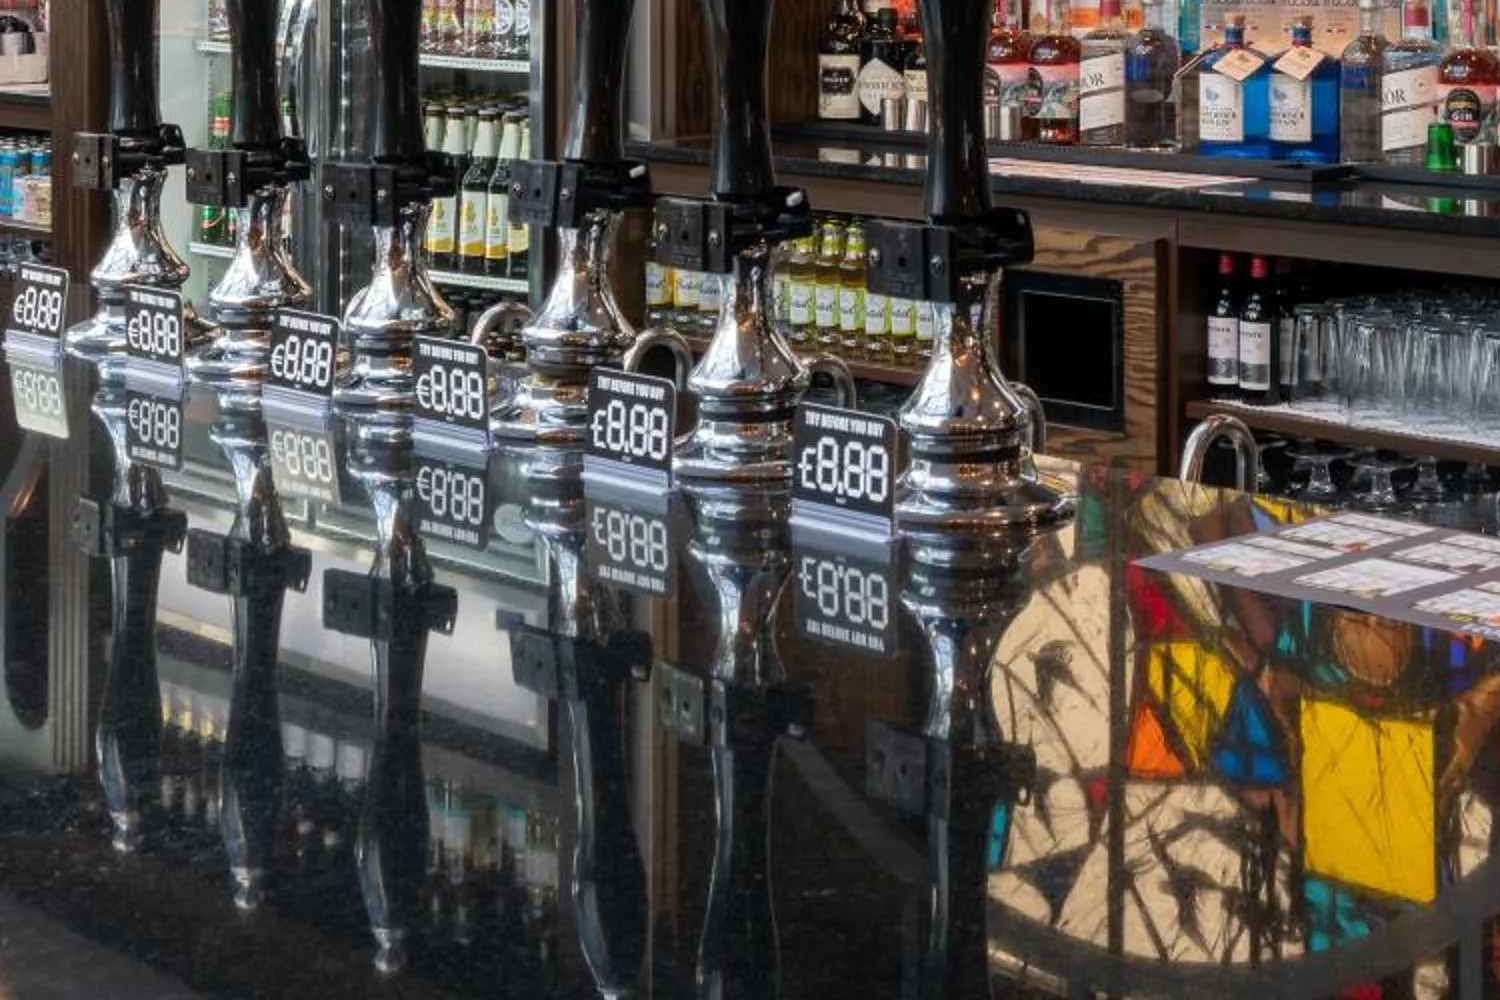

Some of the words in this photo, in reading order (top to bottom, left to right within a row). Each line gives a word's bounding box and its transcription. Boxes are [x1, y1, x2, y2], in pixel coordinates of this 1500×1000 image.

[821, 412, 849, 432] BEFORE
[850, 418, 867, 436] YOU
[867, 420, 885, 438] BUY
